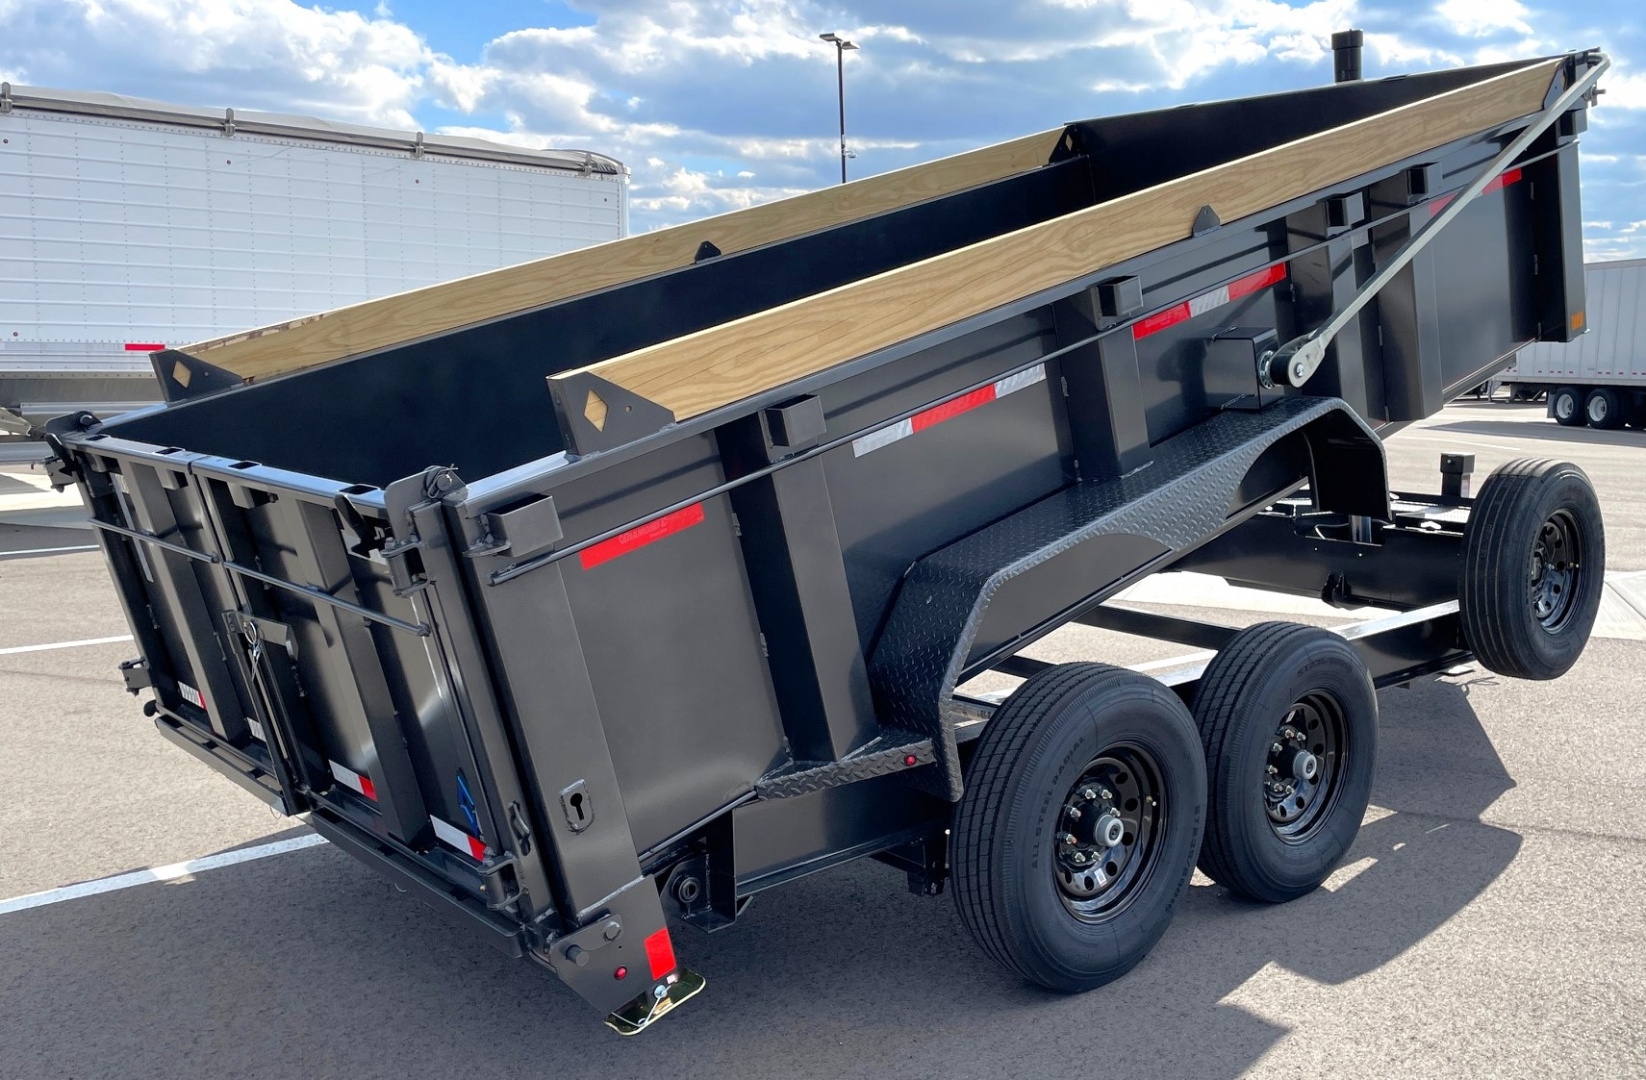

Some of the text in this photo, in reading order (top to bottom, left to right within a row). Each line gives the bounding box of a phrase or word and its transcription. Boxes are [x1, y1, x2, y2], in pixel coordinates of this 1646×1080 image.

[1031, 736, 1085, 869] ALL STEEL RADIAL
